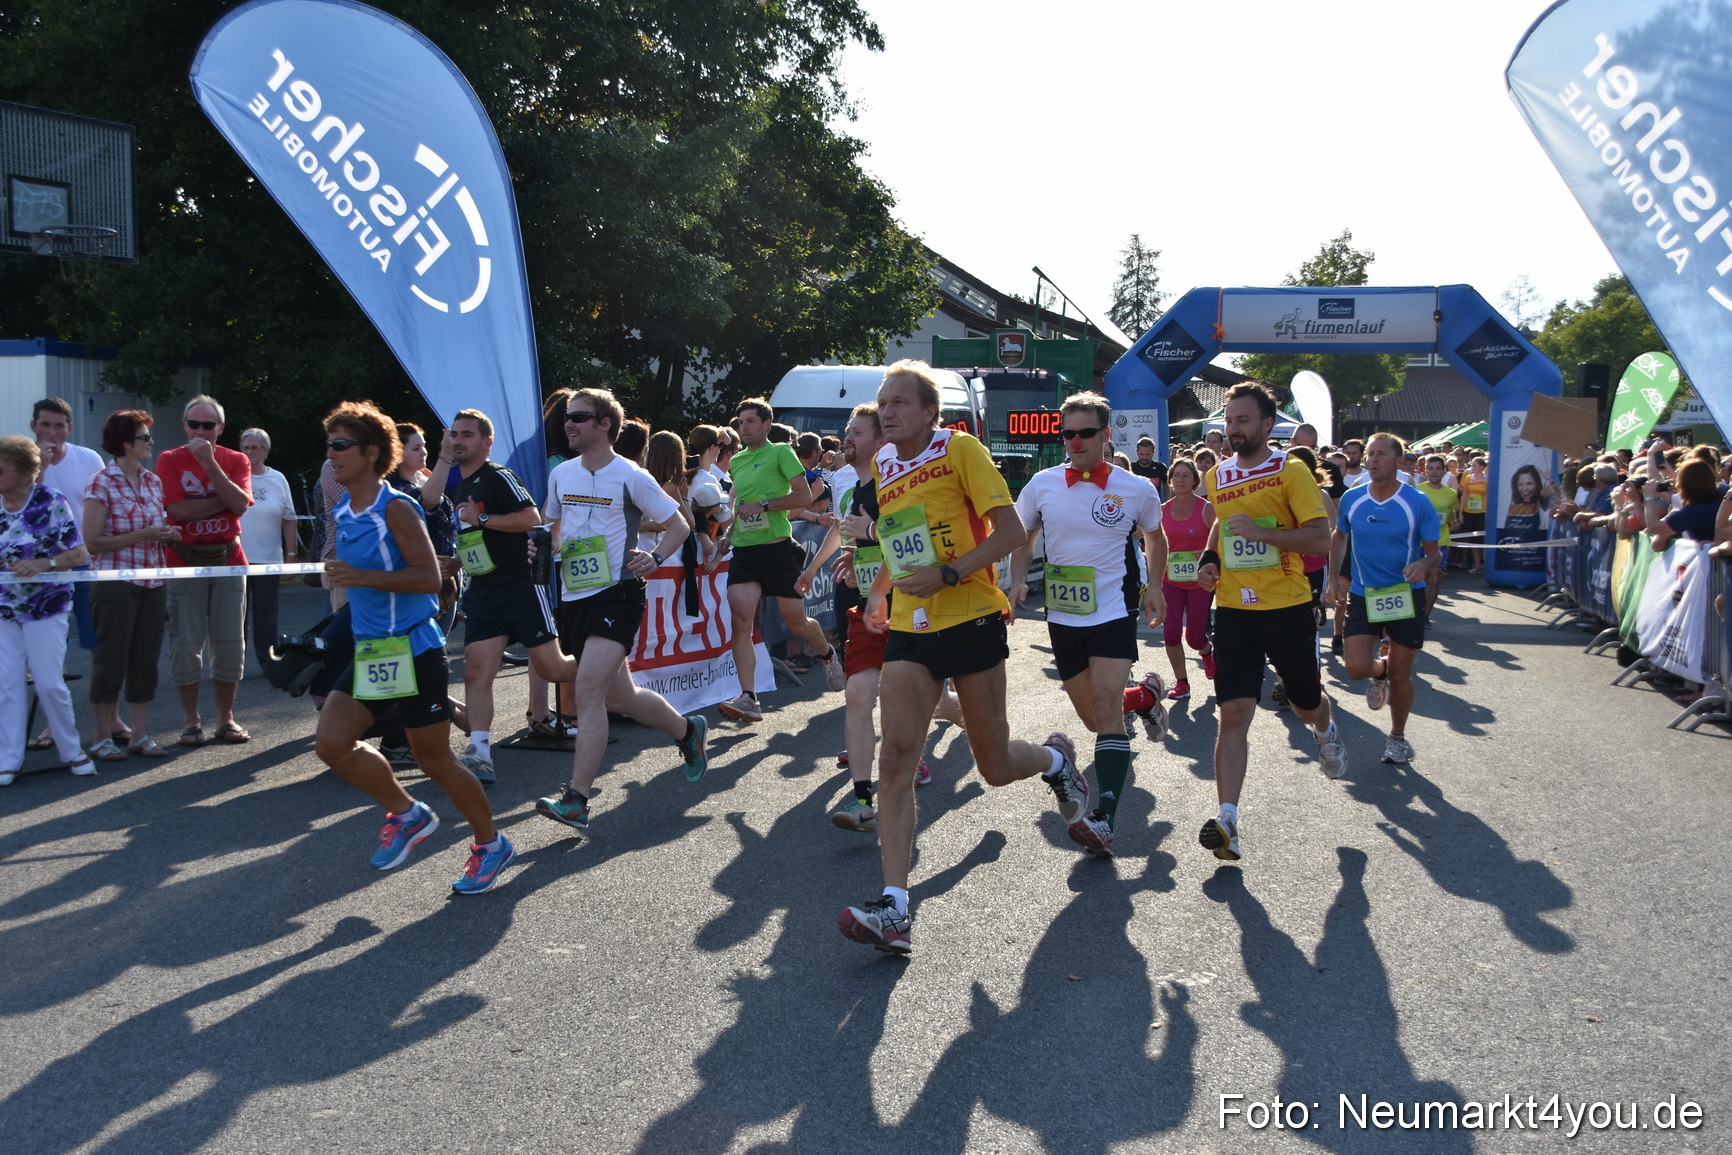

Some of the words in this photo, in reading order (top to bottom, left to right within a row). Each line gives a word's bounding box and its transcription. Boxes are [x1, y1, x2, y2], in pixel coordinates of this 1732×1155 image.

[1304, 319, 1386, 334] firmenlauf
[1153, 347, 1196, 357] Fischer
[1641, 388, 1666, 415] AOK
[1611, 407, 1642, 438] AOK
[909, 464, 954, 490] BÖGL
[1216, 487, 1246, 504] MAX
[1248, 476, 1284, 494] BÖGL
[892, 532, 925, 560] 946
[1233, 539, 1267, 557] 950
[467, 549, 480, 565] 41
[570, 557, 600, 577] 533
[1173, 563, 1195, 574] 349
[1050, 583, 1091, 603] 1218
[1375, 595, 1404, 612] 556
[367, 661, 400, 684] 557
